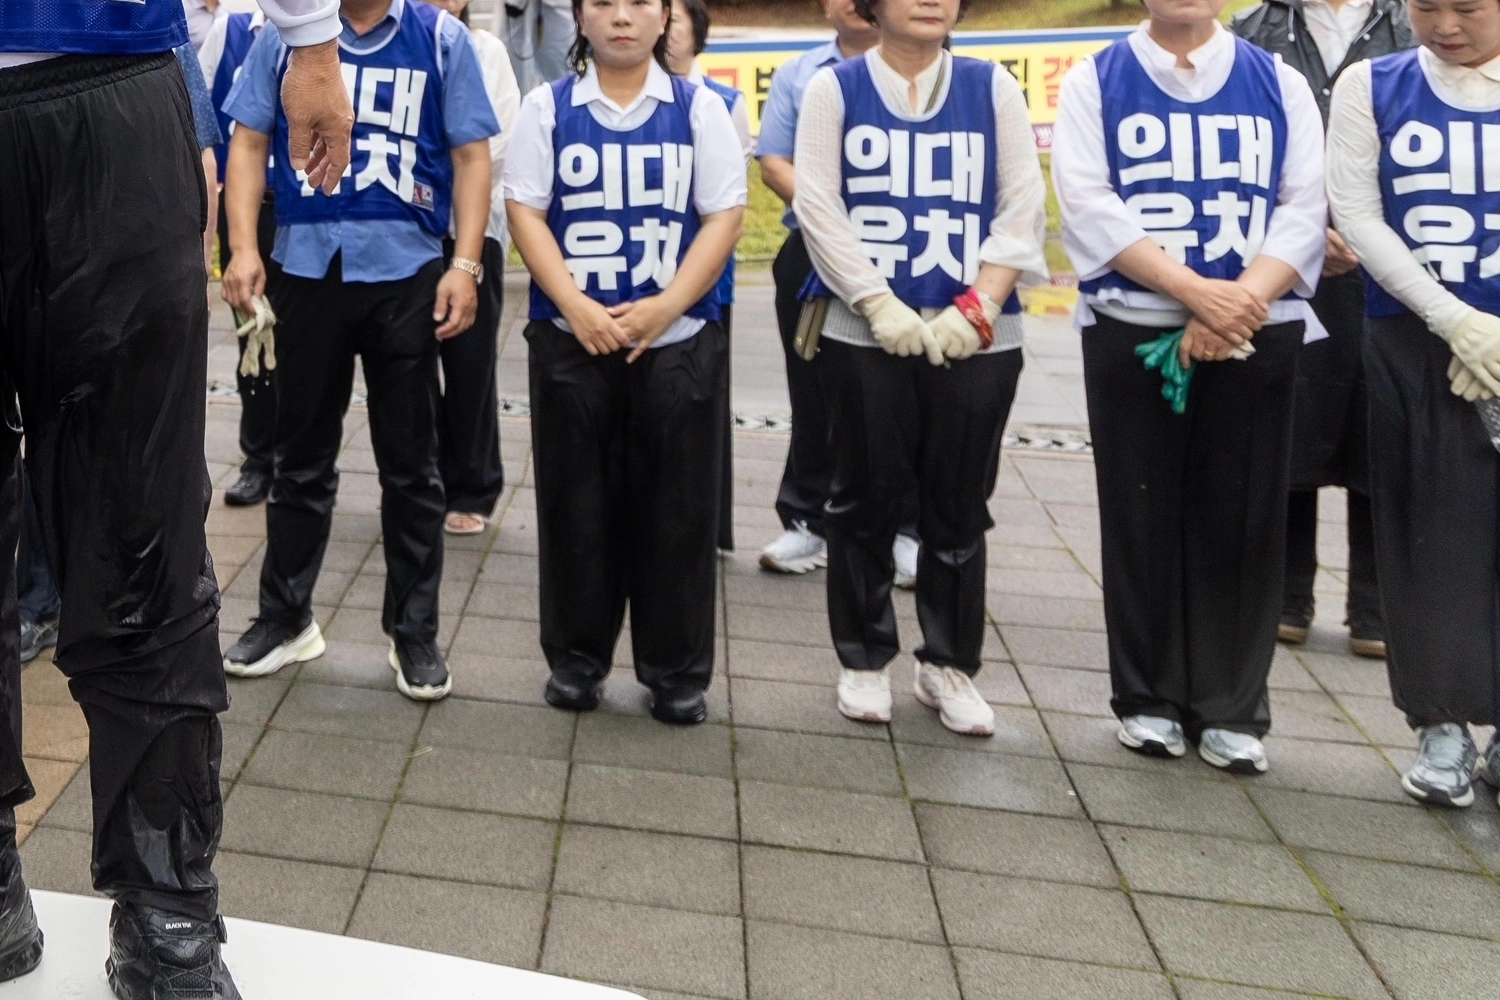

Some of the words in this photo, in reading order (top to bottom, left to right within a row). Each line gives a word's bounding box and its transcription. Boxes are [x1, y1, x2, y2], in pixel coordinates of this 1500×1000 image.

[296, 133, 418, 204] 치
[559, 143, 694, 214] 의대
[845, 125, 985, 205] 의대
[1118, 113, 1273, 190] 의대
[1390, 121, 1500, 195] 의
[564, 218, 684, 292] 유치
[848, 205, 981, 285] 유치
[1126, 190, 1268, 269] 유치
[1403, 205, 1500, 283] 유
